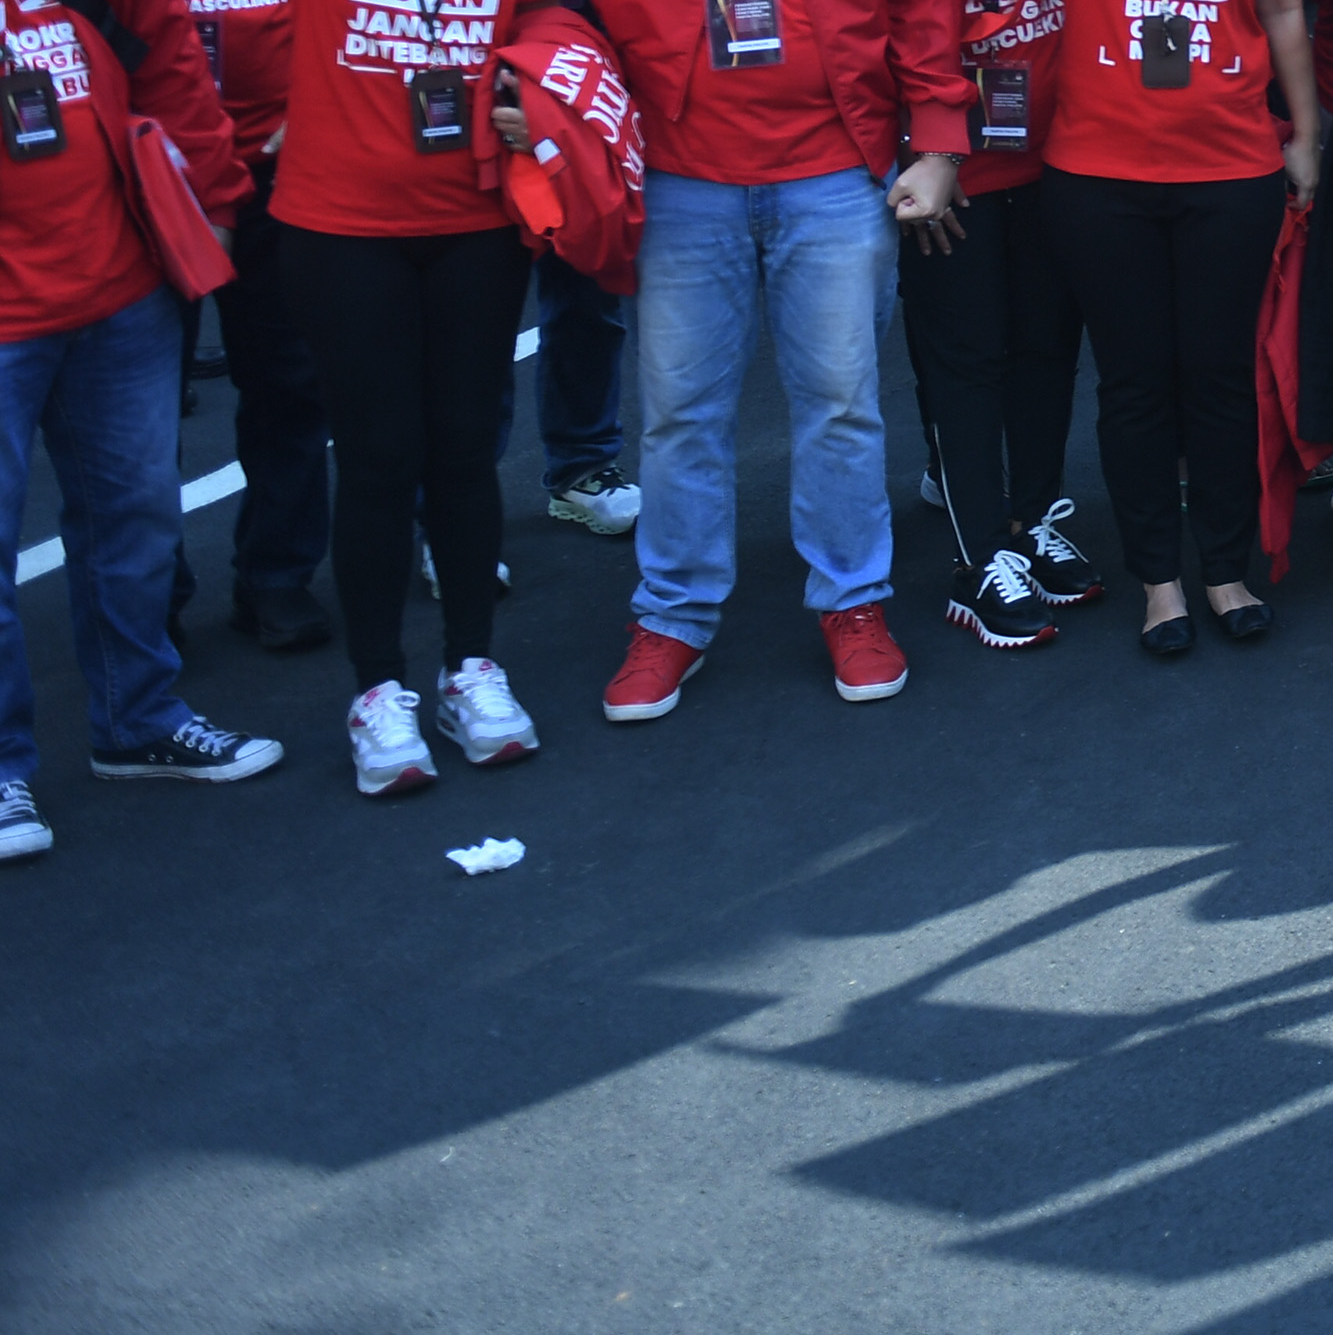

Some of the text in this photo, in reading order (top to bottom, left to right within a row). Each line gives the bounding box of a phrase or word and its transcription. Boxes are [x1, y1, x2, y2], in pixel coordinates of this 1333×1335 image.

[347, 8, 495, 44] JANGAN
[1129, 19, 1212, 42] CA
[345, 33, 489, 66] DITEBANG
[1129, 40, 1211, 63] MPI
